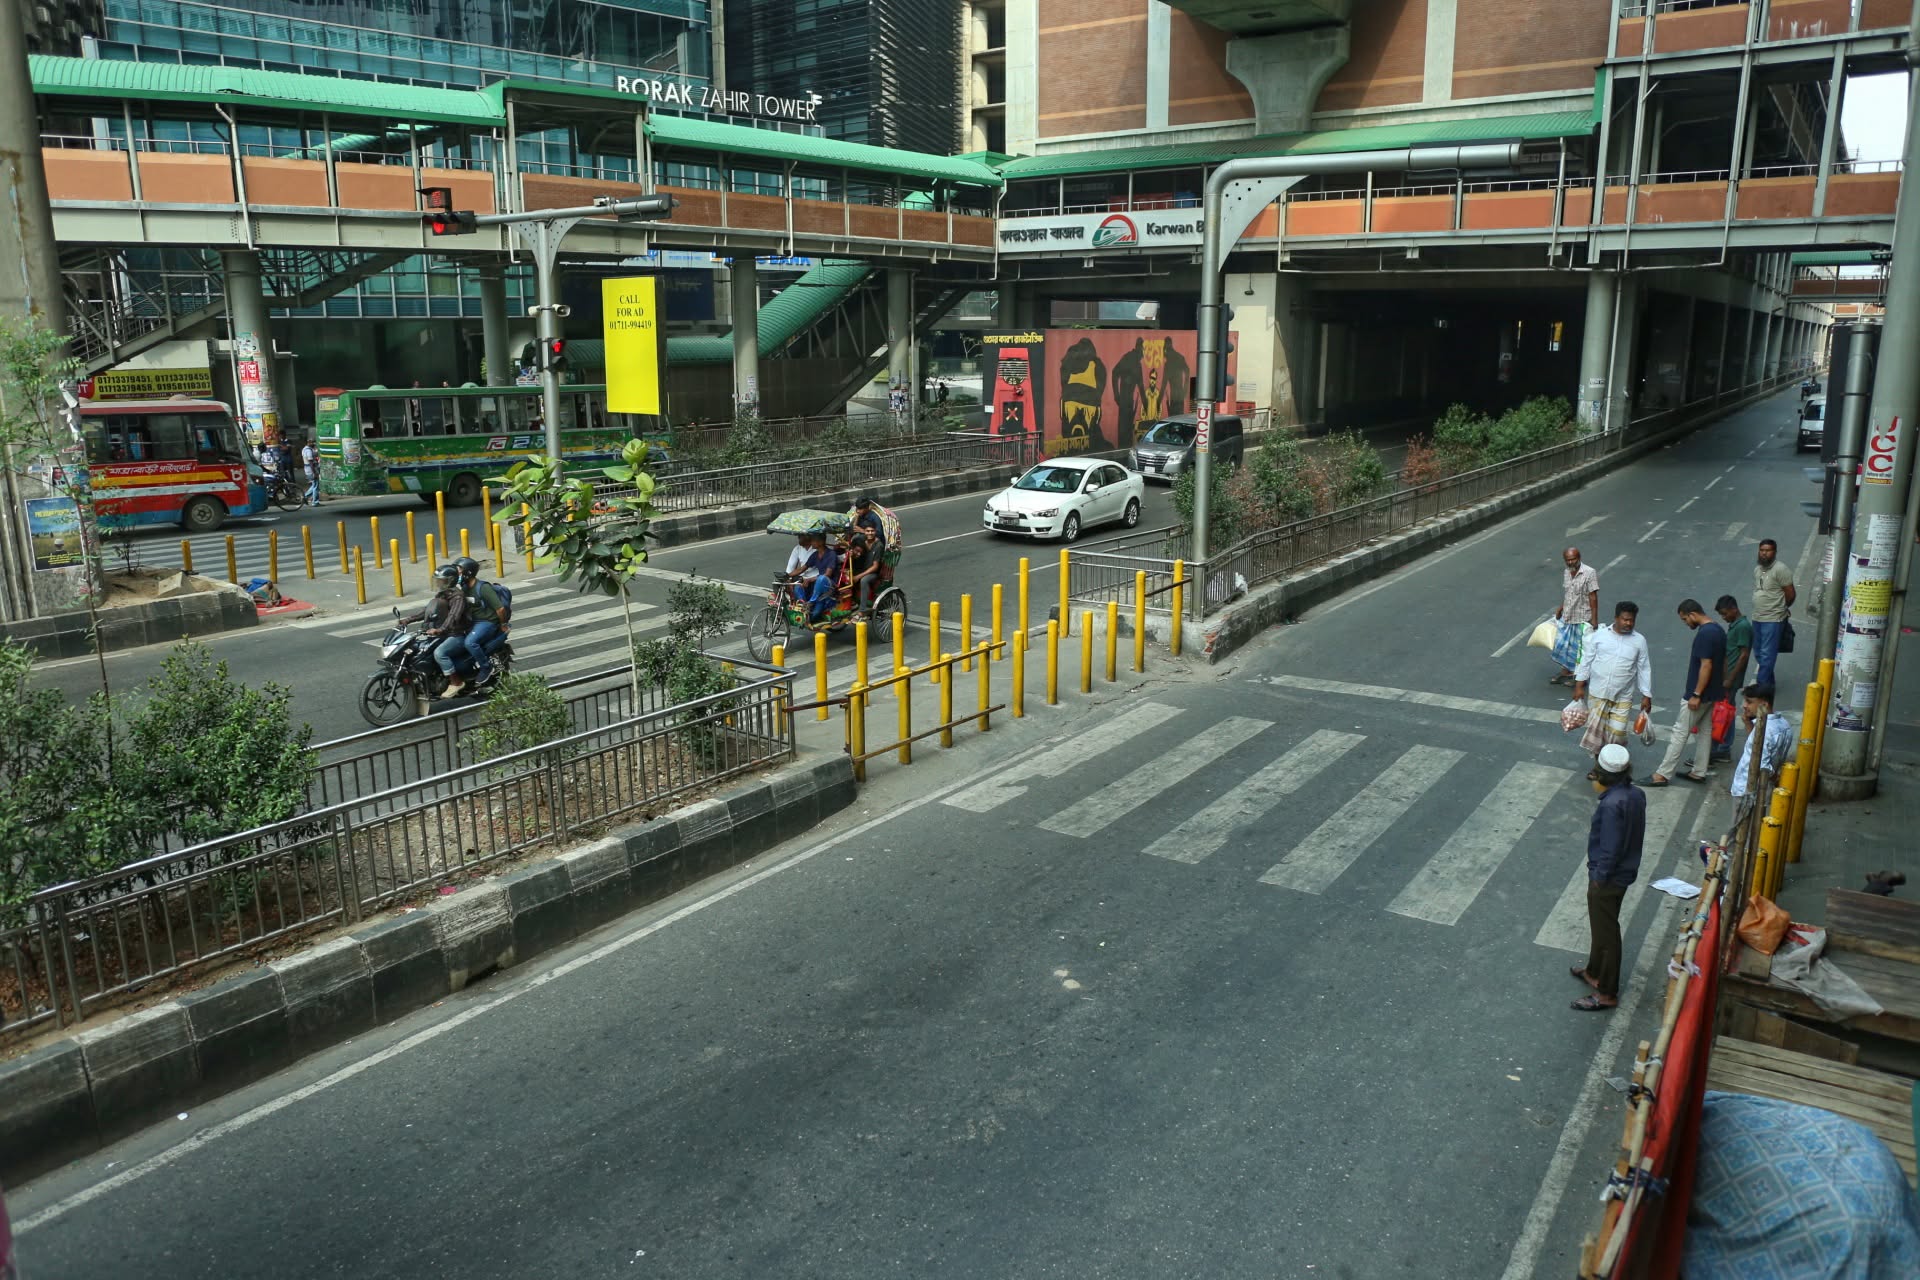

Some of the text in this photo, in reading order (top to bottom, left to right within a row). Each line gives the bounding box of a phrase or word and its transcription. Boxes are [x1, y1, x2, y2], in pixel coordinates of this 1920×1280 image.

[617, 75, 815, 120] BORAK ZAHIR TOWER
[1050, 226, 1084, 240] বাজার
[1146, 222, 1194, 236] Karwan
[619, 294, 641, 304] CALL
[616, 307, 644, 317] FOR AD
[1196, 407, 1210, 444] UCC
